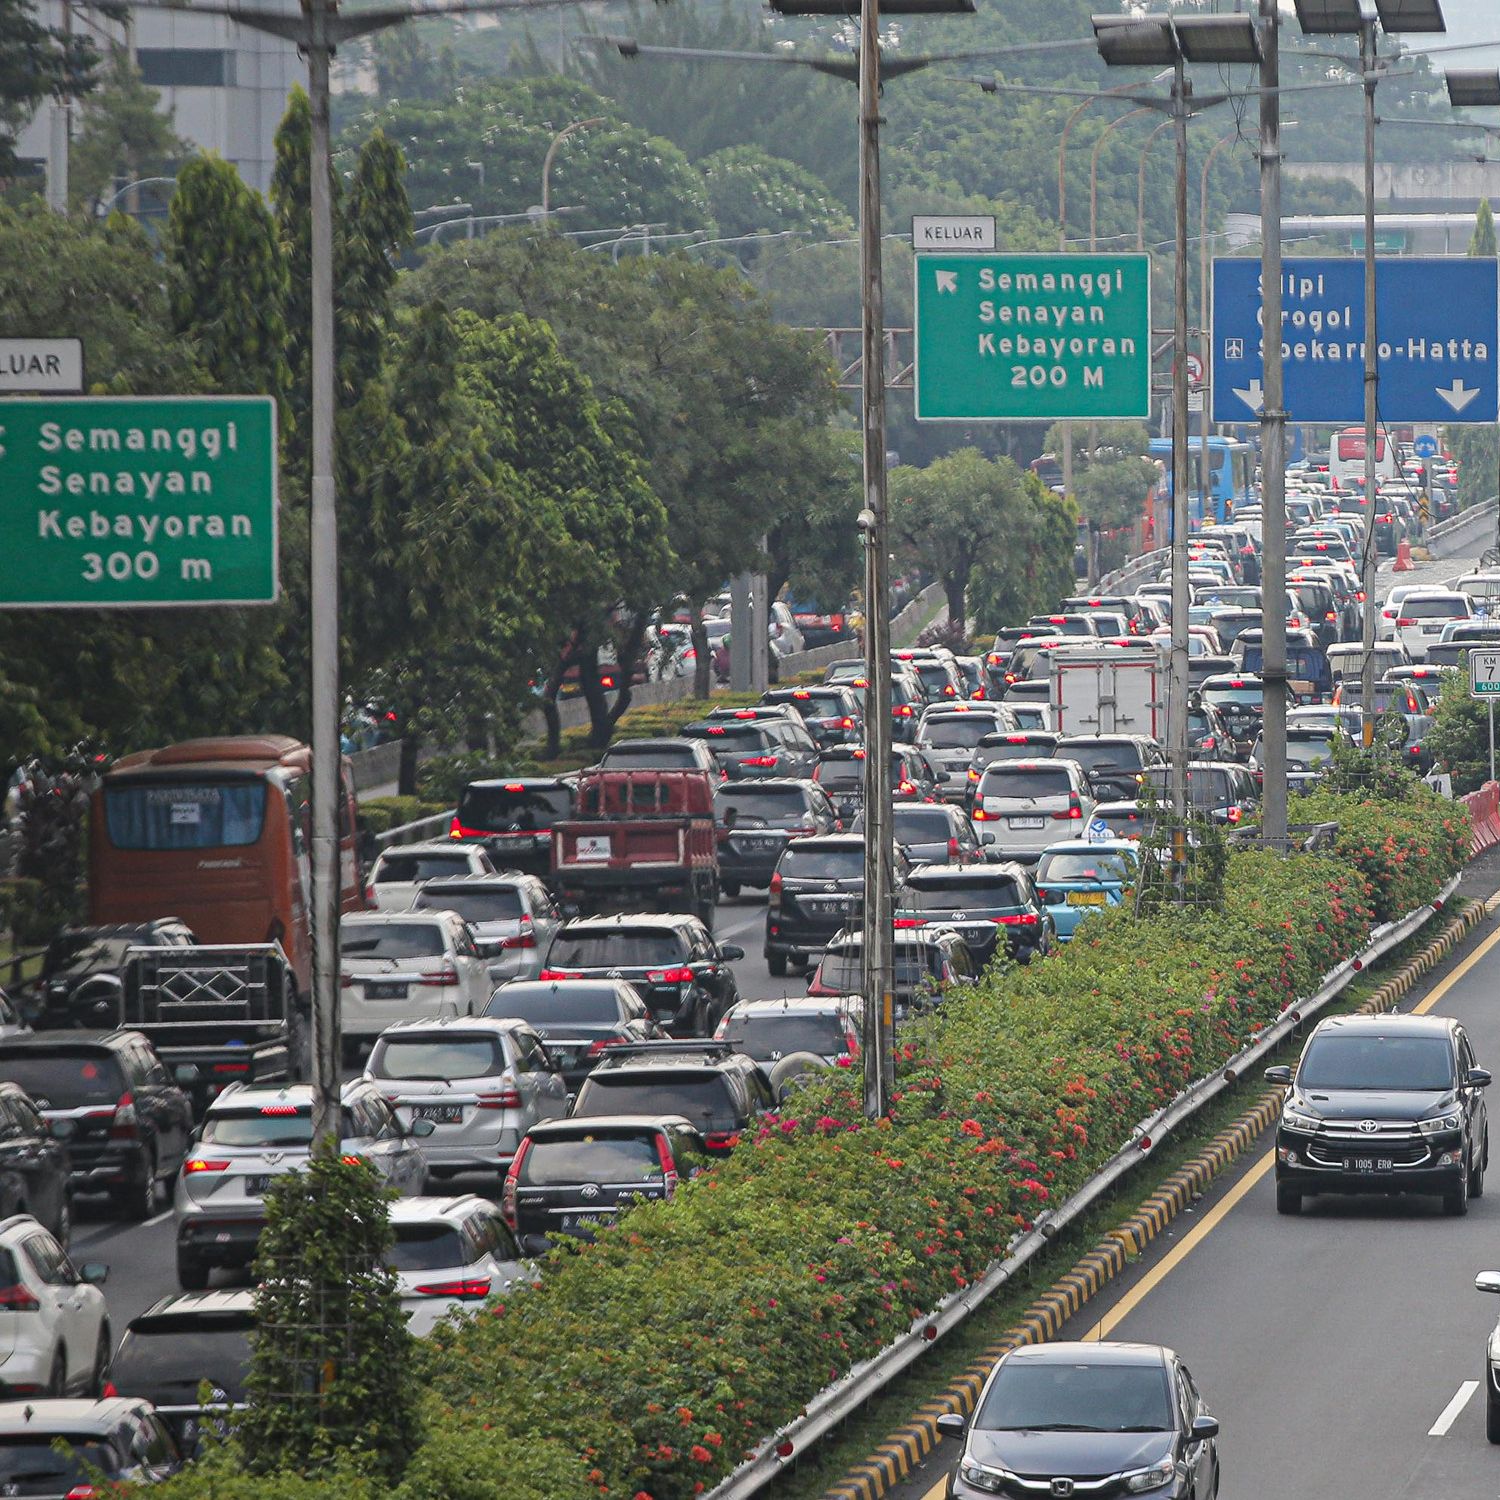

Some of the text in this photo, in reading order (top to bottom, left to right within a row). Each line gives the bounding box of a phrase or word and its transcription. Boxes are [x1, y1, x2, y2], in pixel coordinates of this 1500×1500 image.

[924, 226, 983, 239] KELUAR
[978, 268, 1123, 298] Semanggi
[978, 301, 1105, 326] Senayan
[978, 333, 1136, 358] Kebayoran
[1011, 366, 1104, 387] 200 M
[38, 421, 239, 458] Semanggi
[38, 466, 213, 500] Senayan
[38, 510, 252, 543] Kebayoran
[81, 551, 213, 581] 300 m
[1483, 657, 1497, 665] KM
[1481, 682, 1500, 691] 600
[1485, 667, 1495, 681] 7
[1343, 1159, 1350, 1169] B
[1355, 1159, 1373, 1169] 1005
